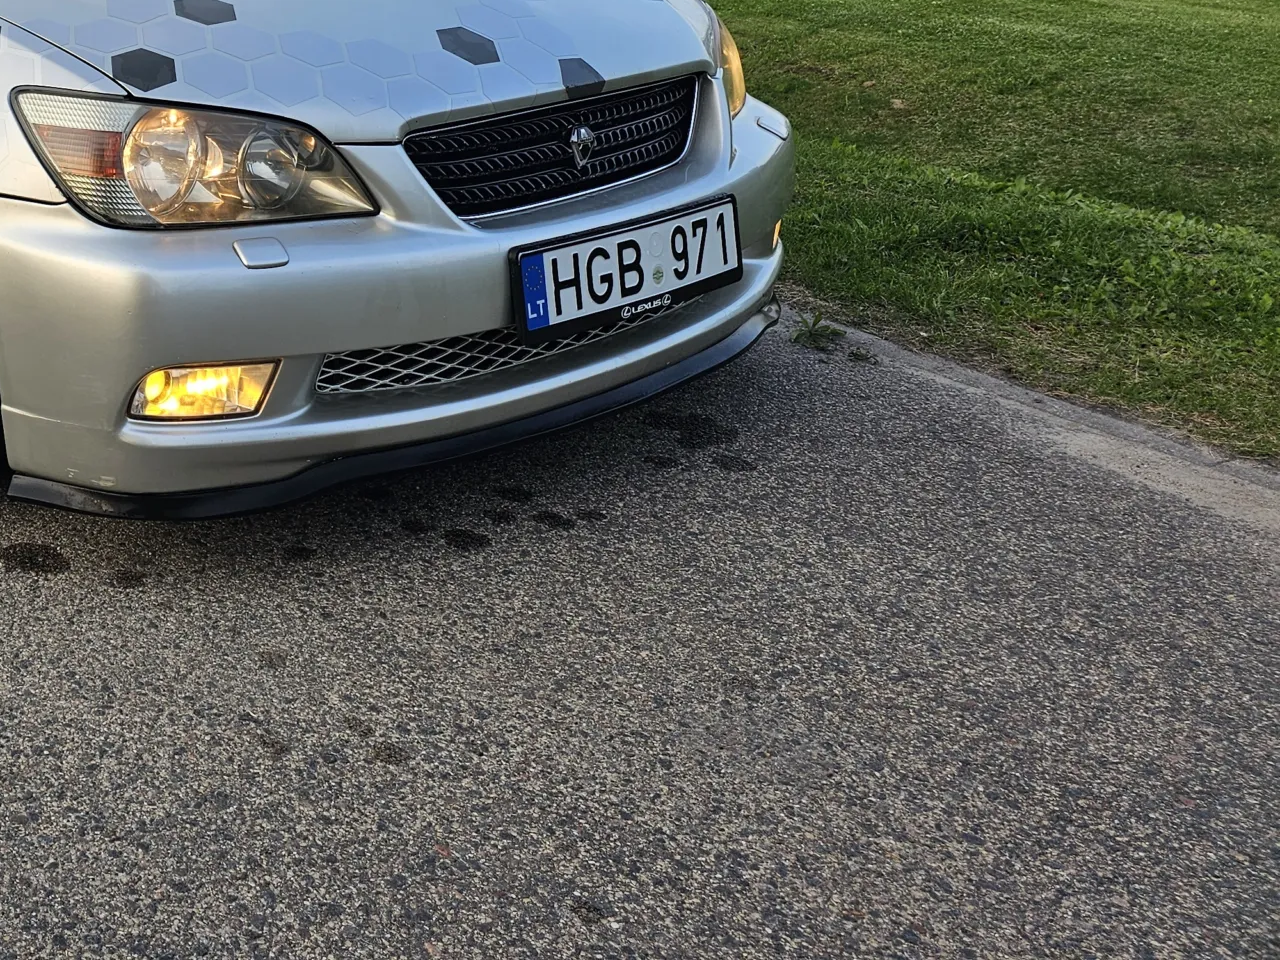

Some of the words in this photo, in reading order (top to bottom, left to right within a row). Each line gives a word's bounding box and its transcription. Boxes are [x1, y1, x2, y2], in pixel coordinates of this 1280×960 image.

[551, 239, 644, 316] HGB
[671, 212, 728, 281] 971
[527, 300, 546, 319] LT
[632, 298, 662, 314] LEXUS
